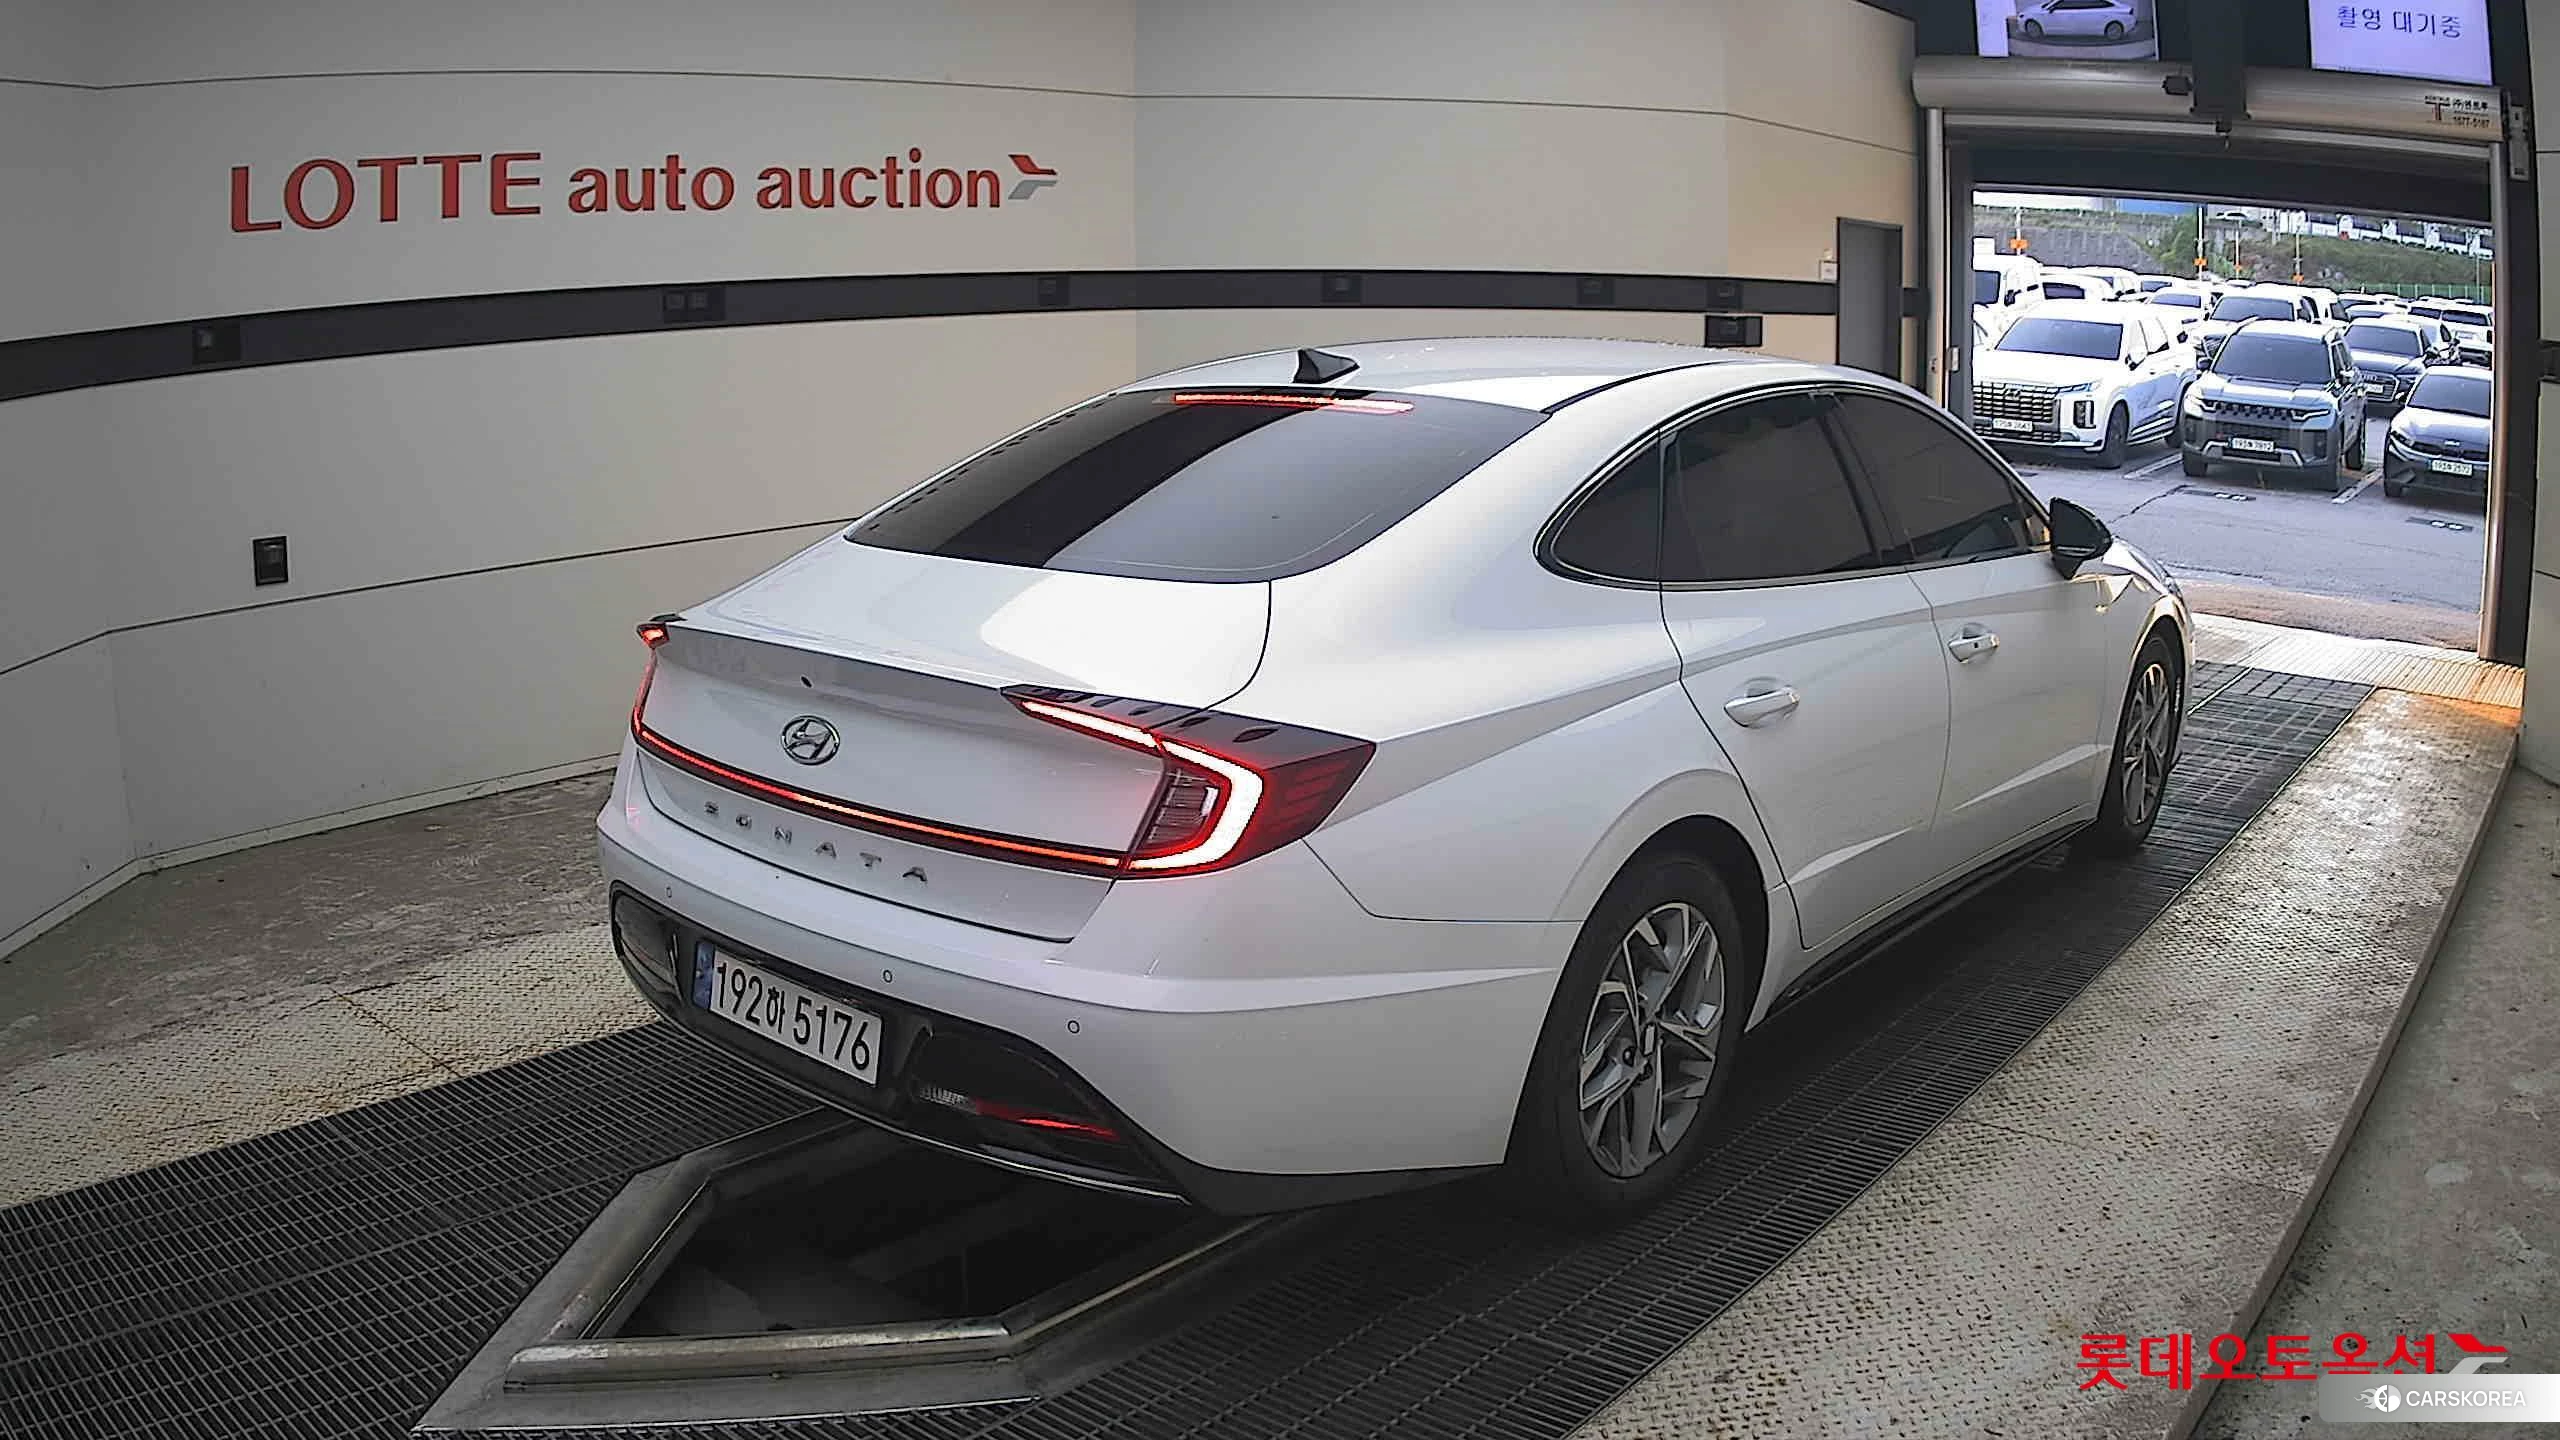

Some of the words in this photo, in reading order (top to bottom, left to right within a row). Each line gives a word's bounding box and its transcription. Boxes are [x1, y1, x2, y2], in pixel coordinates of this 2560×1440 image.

[2338, 6, 2382, 31] 촬영
[2393, 11, 2462, 39] 대기중
[231, 152, 542, 233] LOTTE
[569, 153, 735, 213] auto
[757, 147, 1001, 210] auction
[704, 800, 928, 883] SONATA
